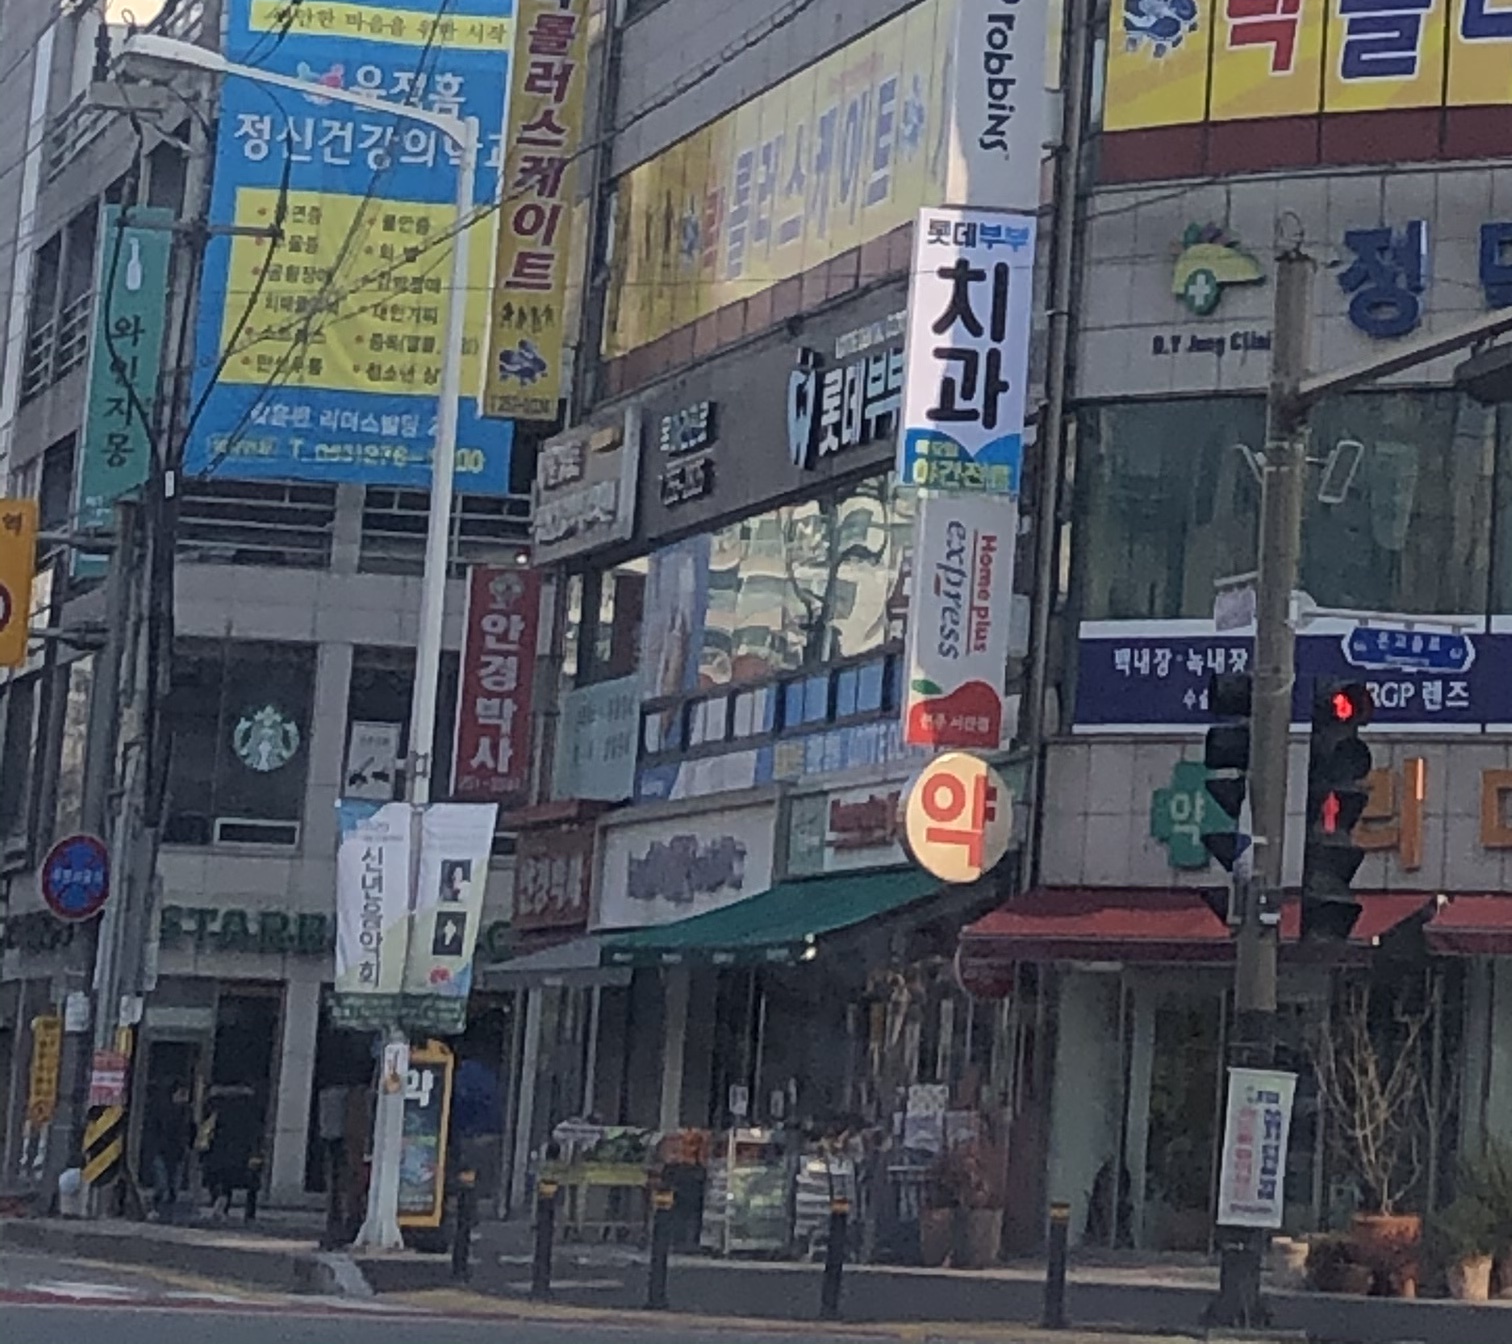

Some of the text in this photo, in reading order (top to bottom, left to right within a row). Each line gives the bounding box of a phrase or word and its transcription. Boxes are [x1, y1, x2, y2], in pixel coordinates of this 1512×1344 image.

[978, 13, 1017, 153] robbins
[927, 217, 1030, 252] 롯데부부
[925, 257, 1010, 430] 치과
[1422, 679, 1470, 711] 렌즈
[921, 771, 998, 870] 약
